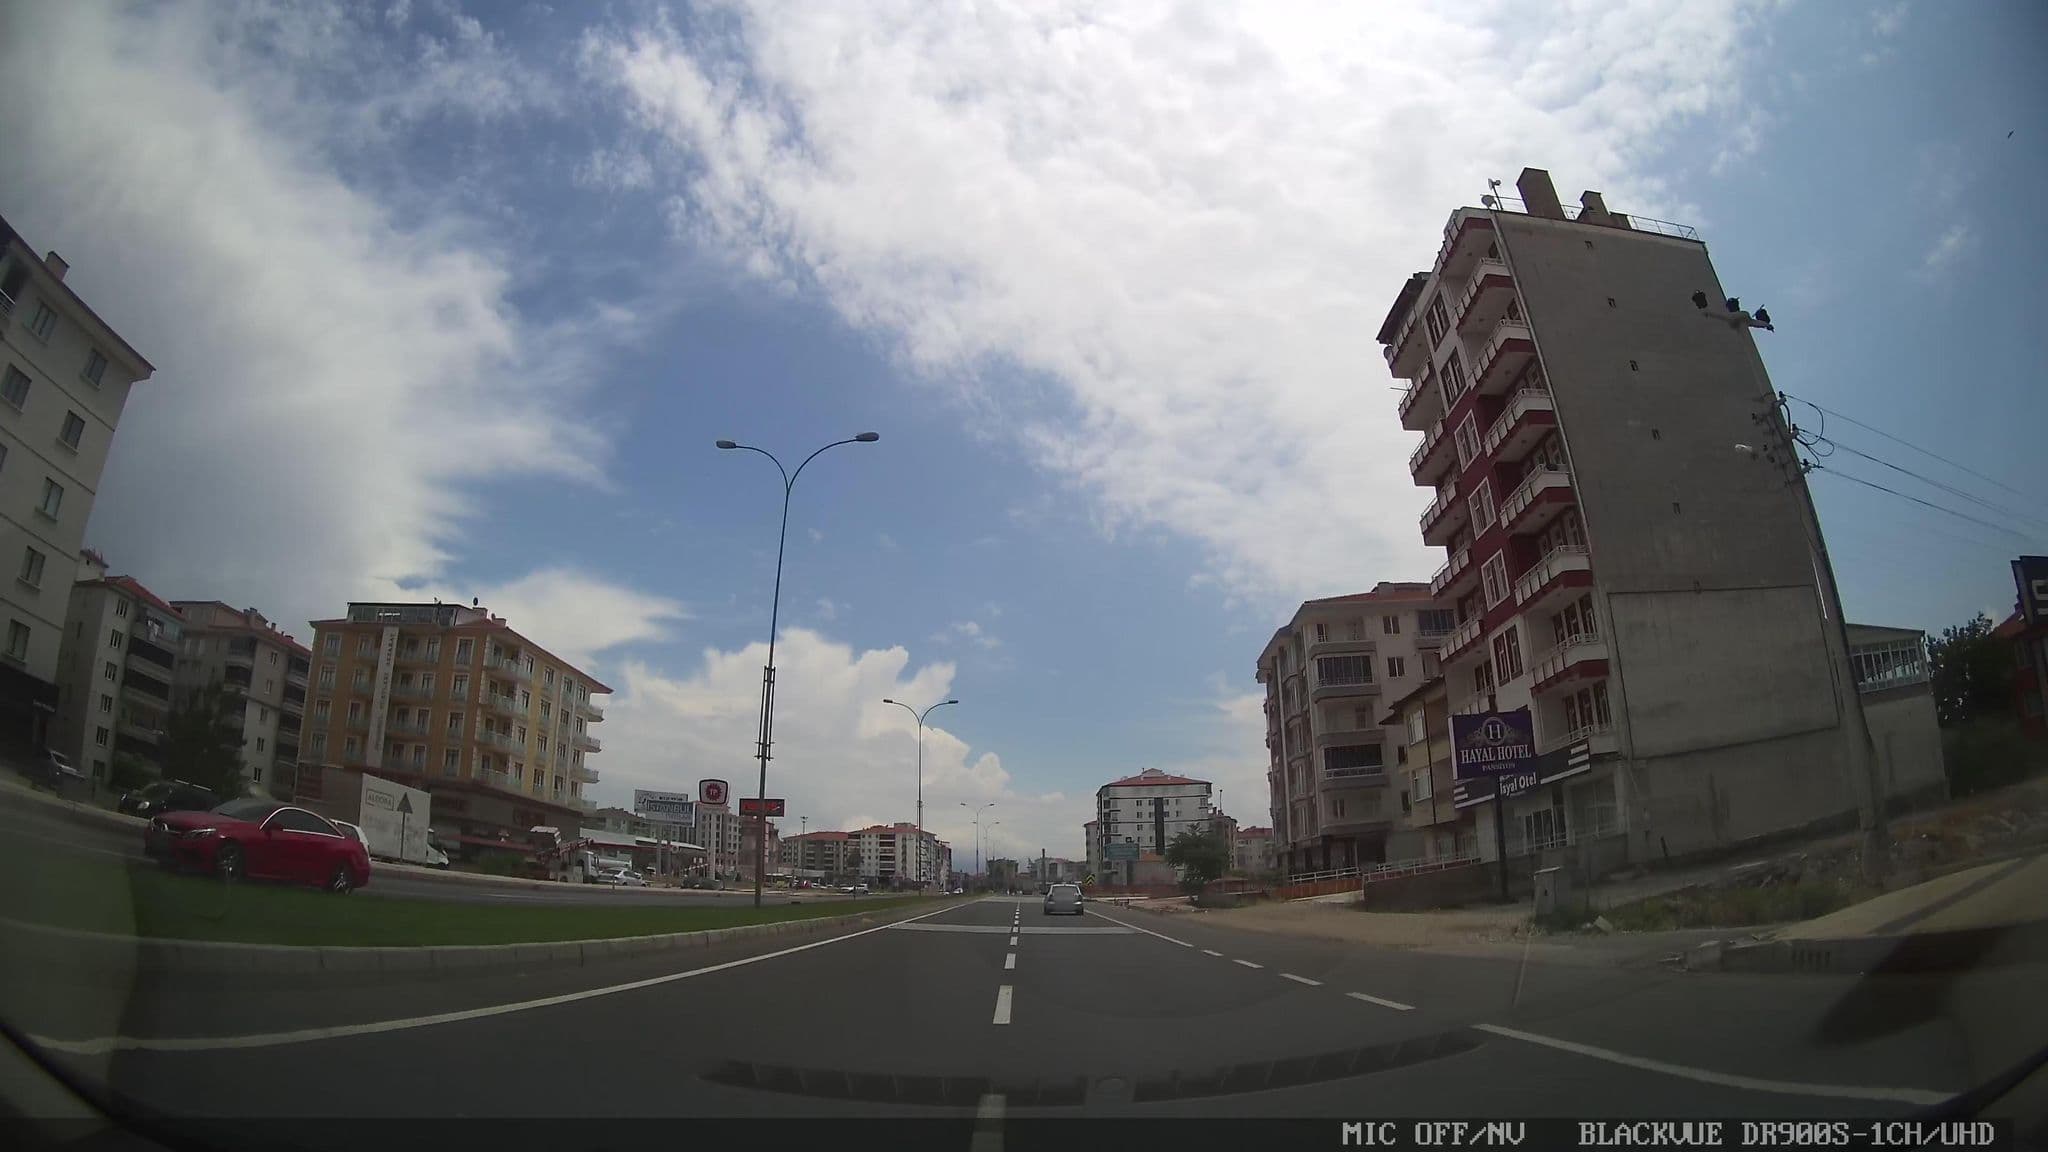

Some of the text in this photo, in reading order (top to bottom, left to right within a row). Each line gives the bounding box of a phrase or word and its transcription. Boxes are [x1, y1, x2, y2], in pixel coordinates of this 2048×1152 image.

[1460, 744, 1532, 764] HAYAL HOTEL
[1519, 772, 1537, 789] Otel
